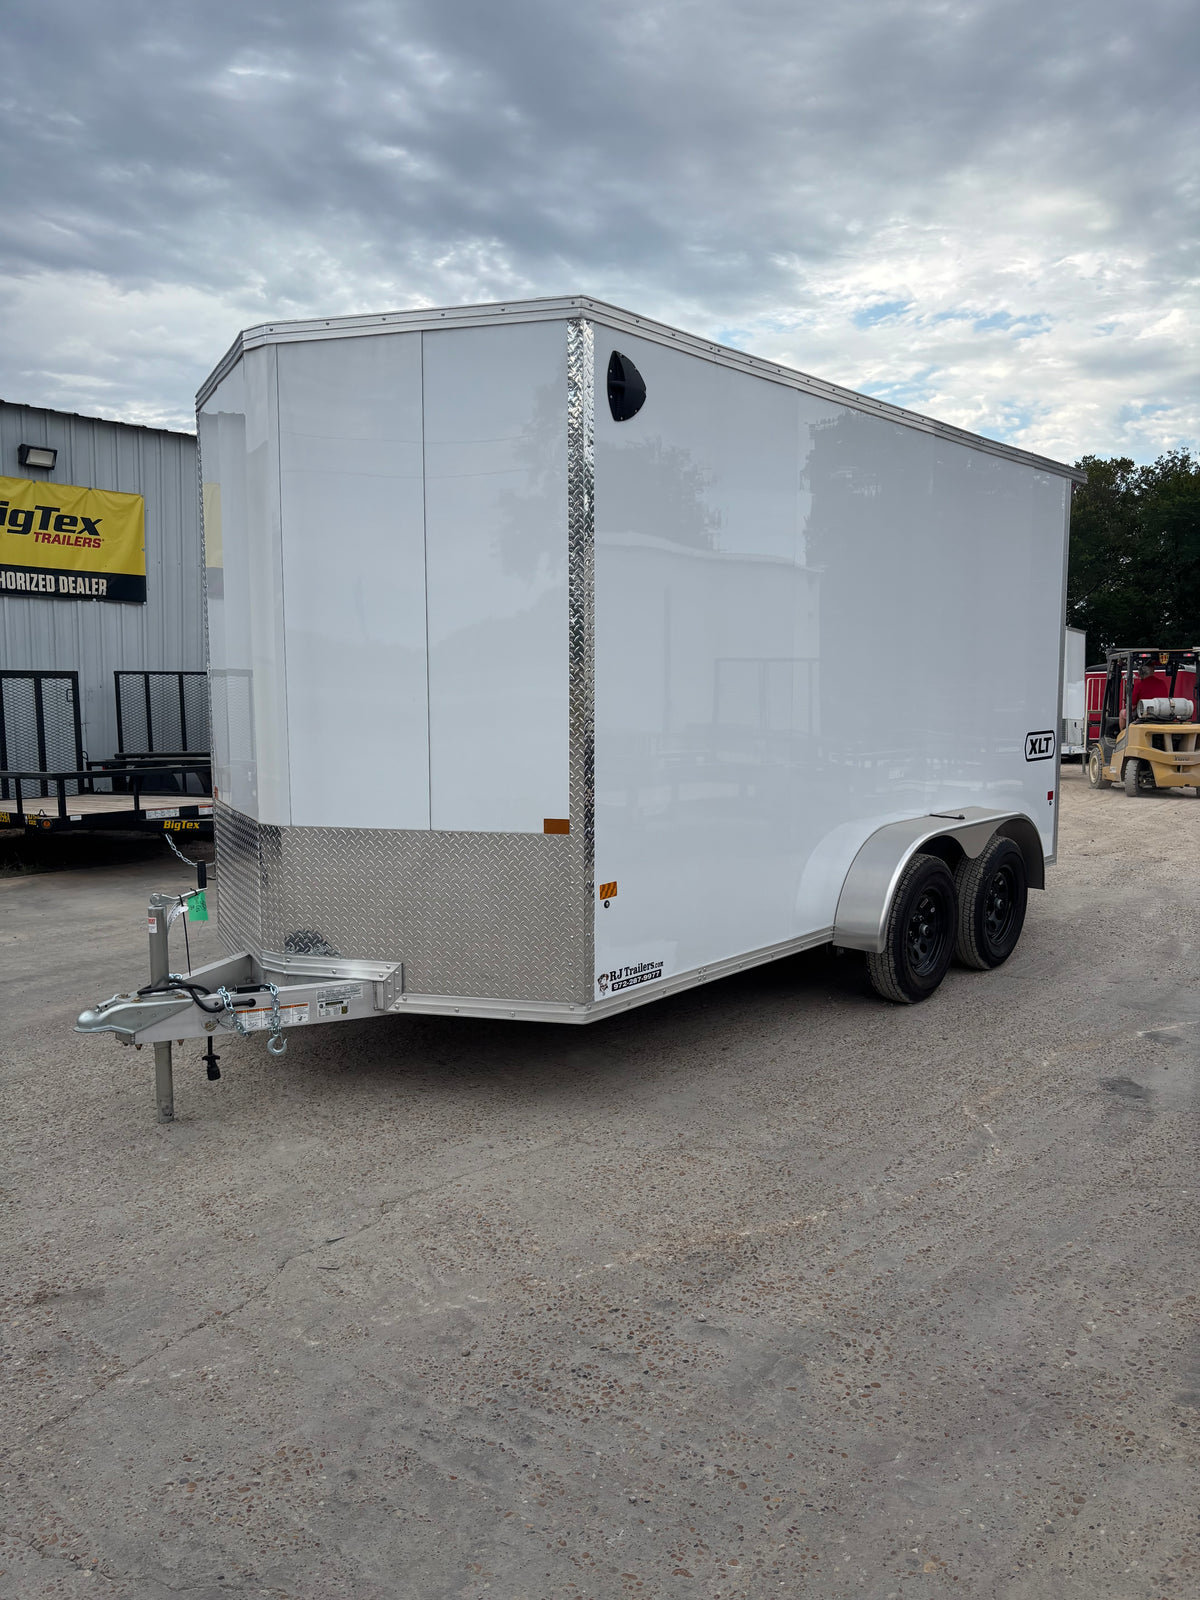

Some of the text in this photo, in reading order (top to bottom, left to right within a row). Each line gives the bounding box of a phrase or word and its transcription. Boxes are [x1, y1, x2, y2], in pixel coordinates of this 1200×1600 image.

[33, 532, 102, 549] TRAILERS
[58, 575, 107, 596] DEALER
[1028, 736, 1053, 756] XLT
[163, 820, 200, 832] BigTex
[609, 968, 624, 982] RJ
